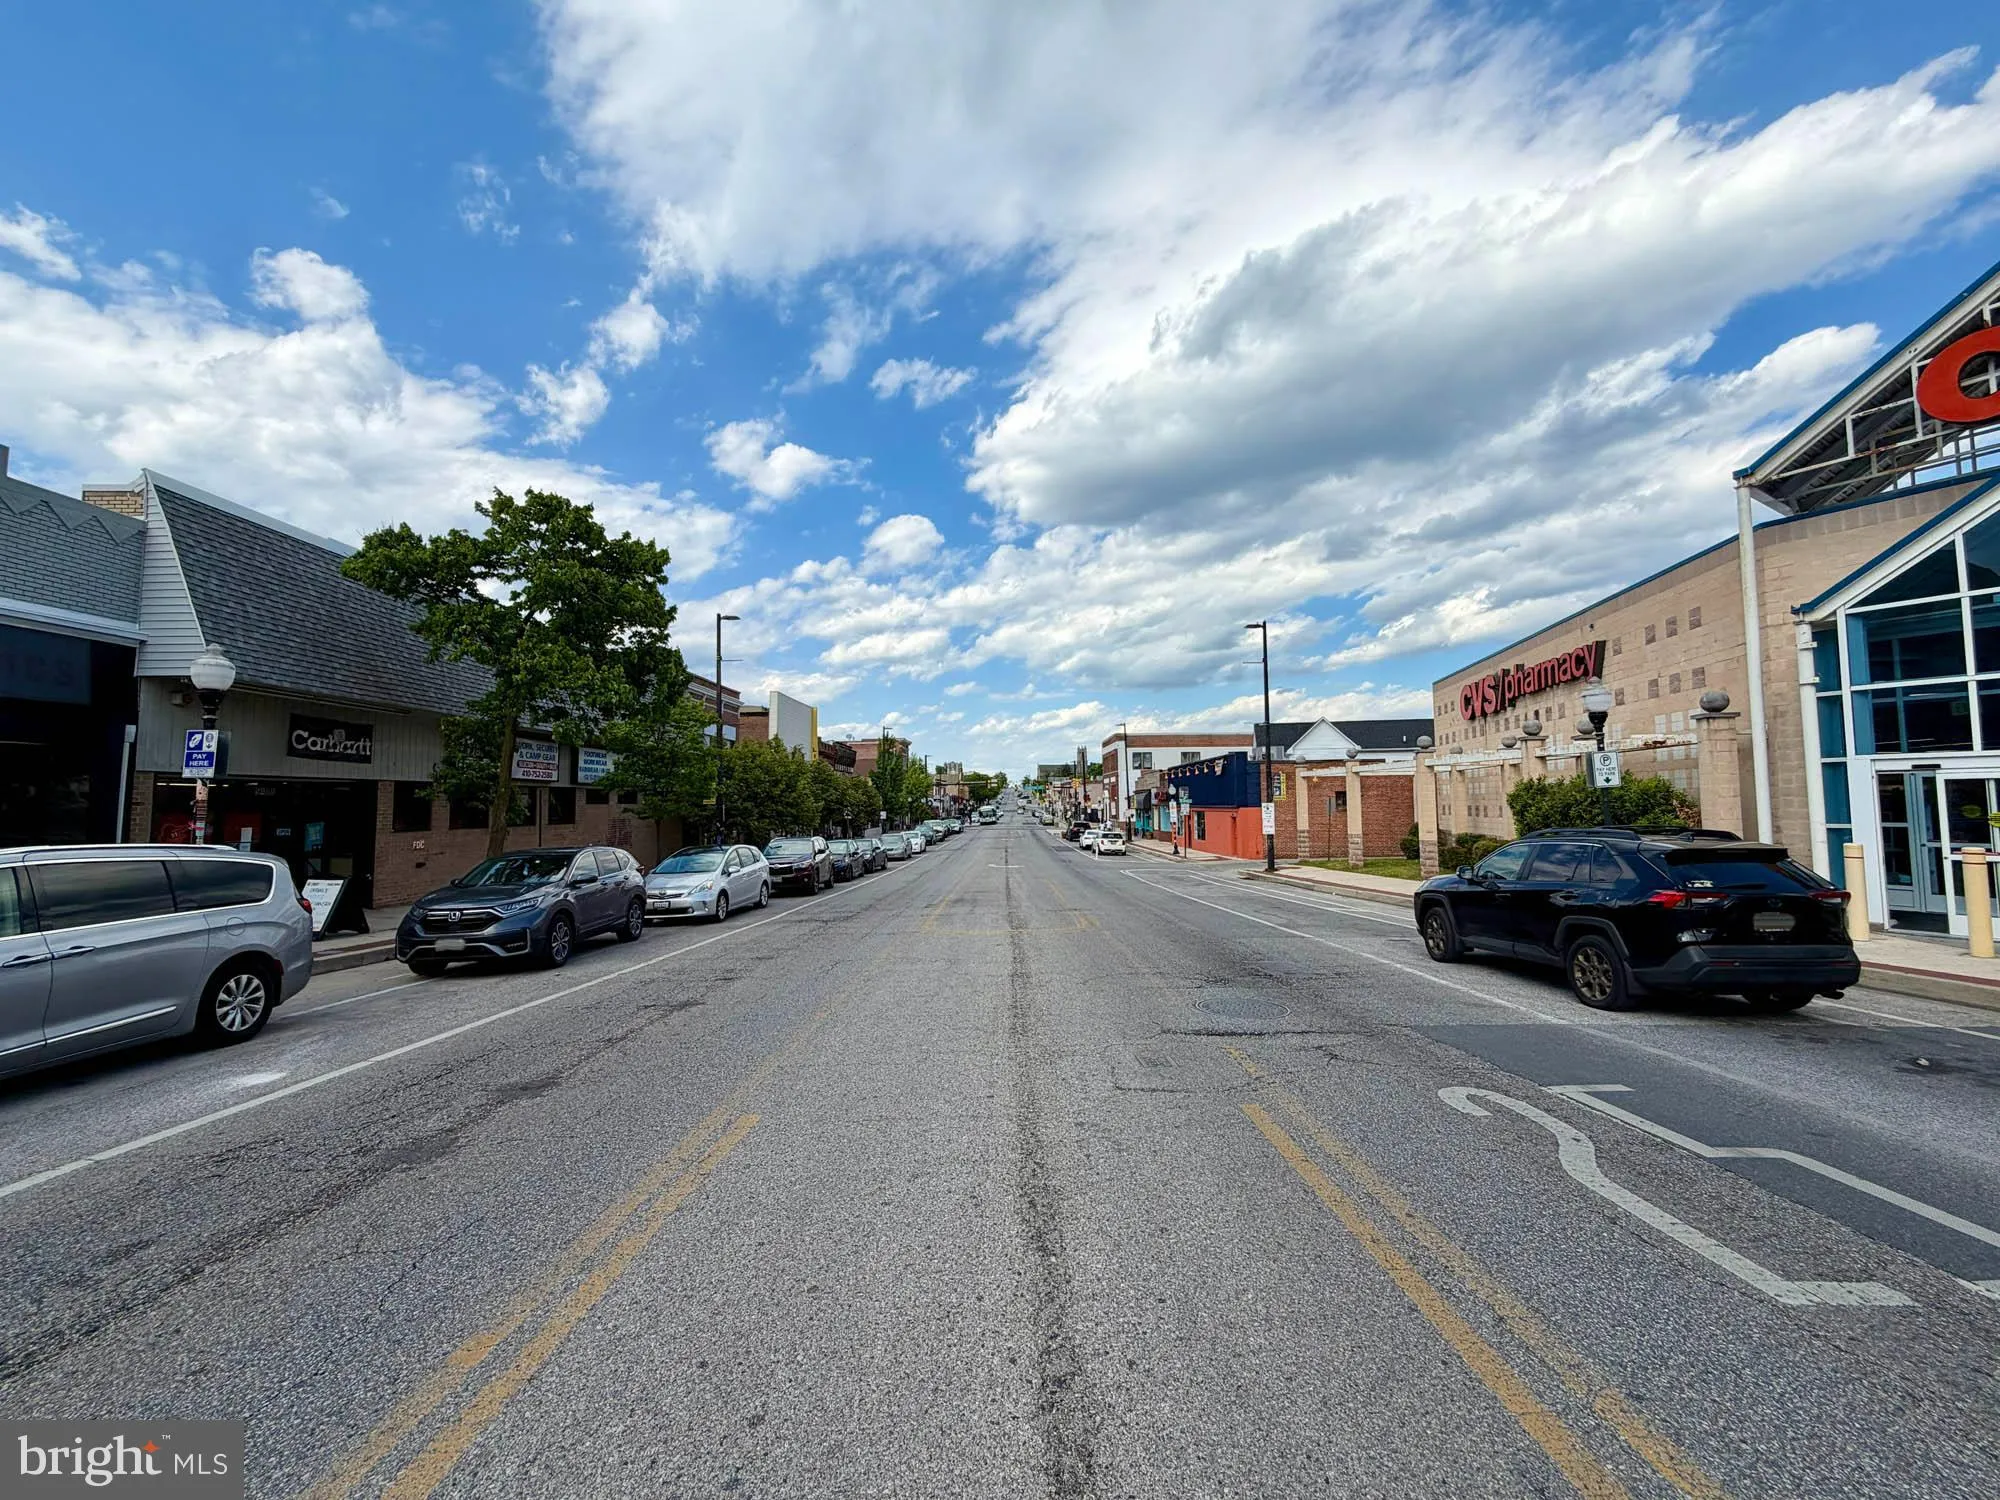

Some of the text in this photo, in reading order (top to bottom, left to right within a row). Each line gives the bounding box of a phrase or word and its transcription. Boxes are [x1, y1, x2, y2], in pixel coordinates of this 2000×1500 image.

[1459, 640, 1597, 721] CVS/pharmacy
[291, 729, 372, 756] Carhartt
[525, 751, 542, 760] CAMP
[543, 753, 556, 761] GEAR
